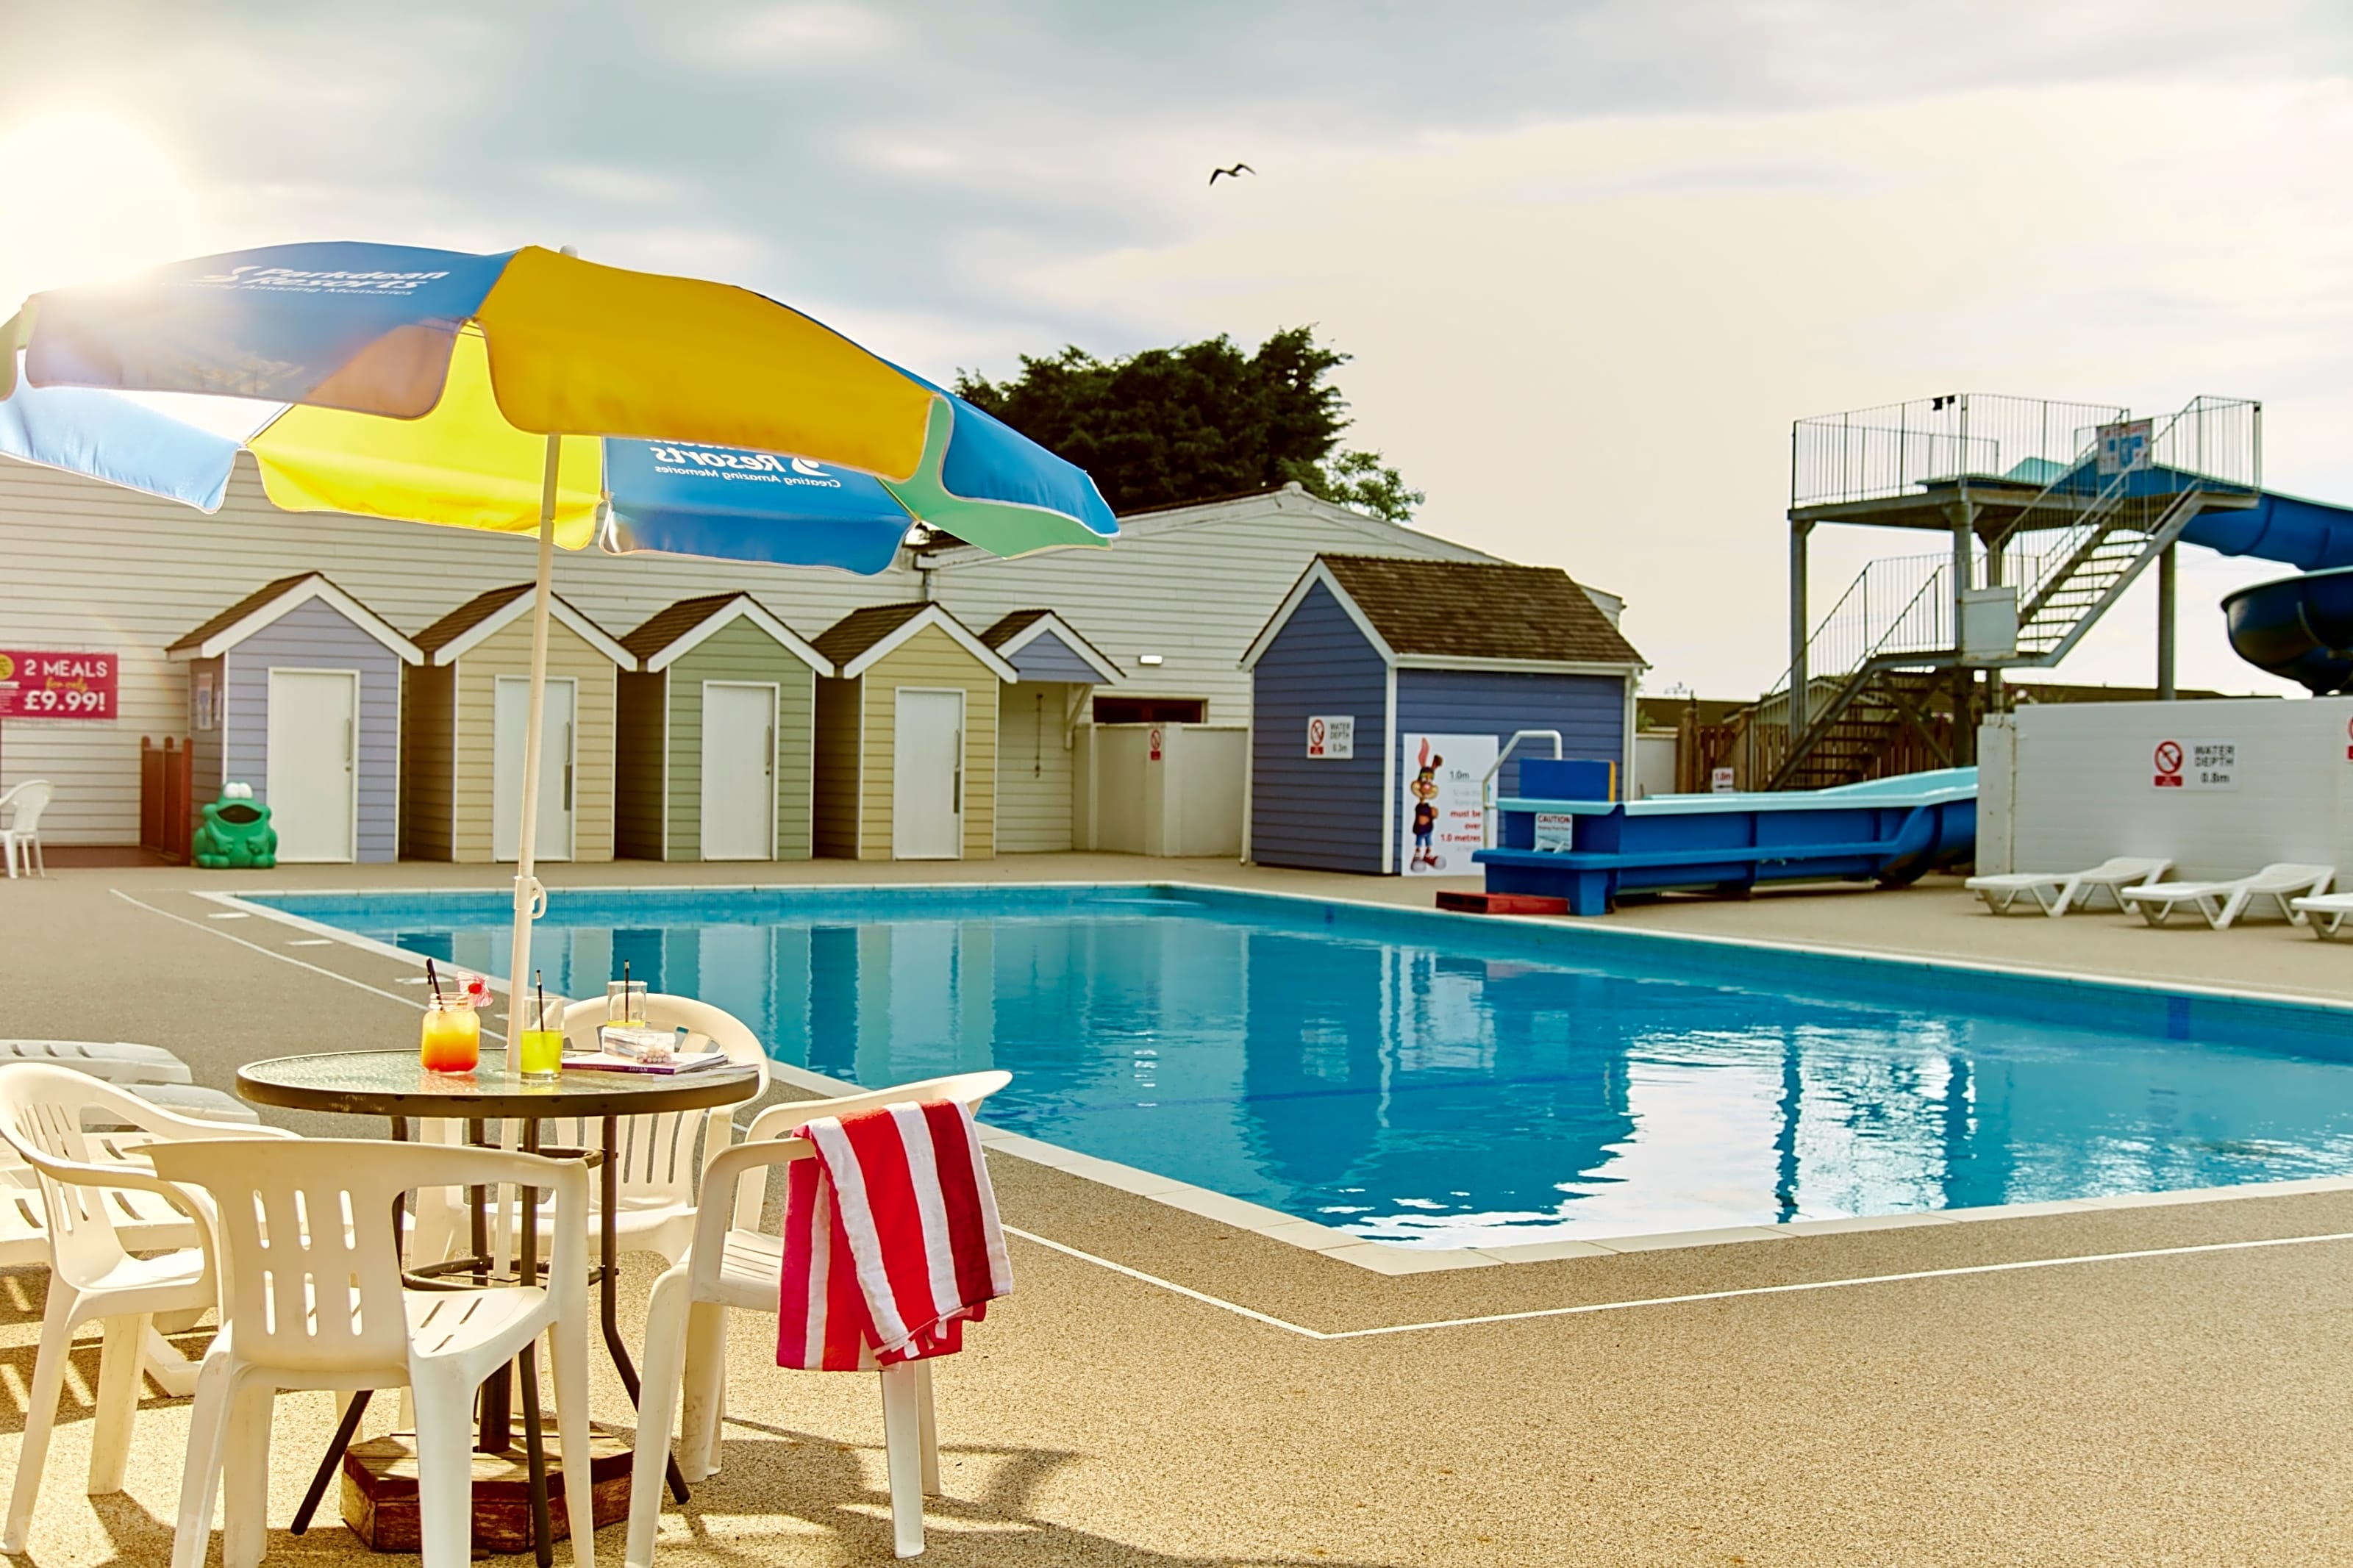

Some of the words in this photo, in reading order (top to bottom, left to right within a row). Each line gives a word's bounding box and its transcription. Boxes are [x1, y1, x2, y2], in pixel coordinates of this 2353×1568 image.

[253, 268, 451, 280] Parkdean
[240, 276, 429, 289] Resorts
[24, 659, 37, 676] 2
[43, 659, 108, 678] MEALS
[24, 690, 106, 712] £9.99!
[2194, 745, 2235, 755] WATER
[2194, 756, 2234, 767] DEPTH
[1538, 815, 1571, 823] CAUTION
